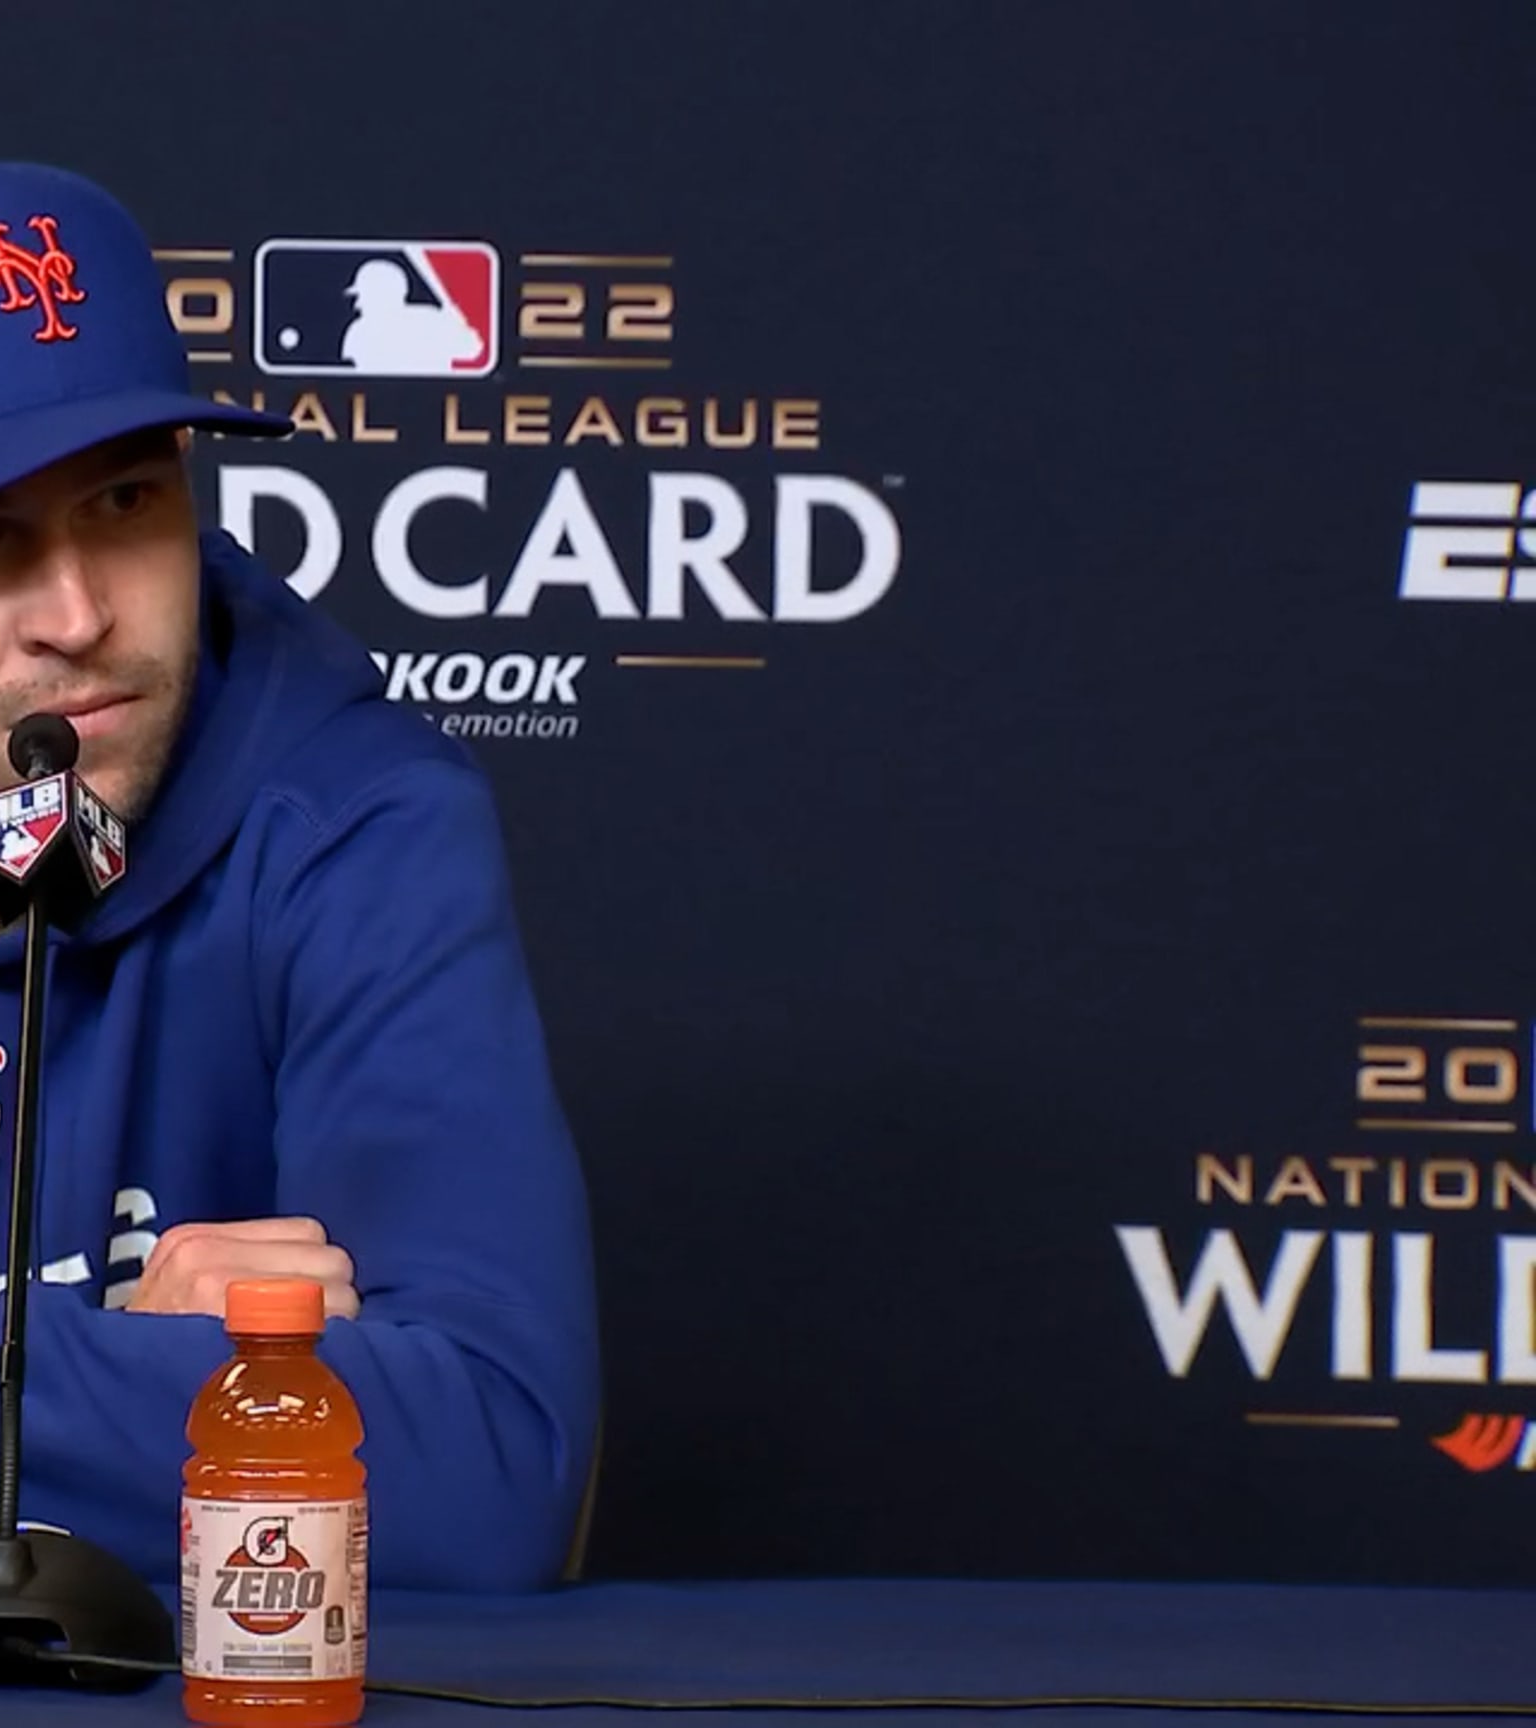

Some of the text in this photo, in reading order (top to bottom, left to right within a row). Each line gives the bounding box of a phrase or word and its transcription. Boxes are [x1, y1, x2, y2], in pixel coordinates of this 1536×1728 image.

[519, 283, 674, 340] 22
[444, 395, 821, 449] LEAGUE
[372, 466, 902, 623] CARD
[441, 710, 580, 738] emotion
[77, 786, 122, 848] MLB
[1357, 1046, 1518, 1103] 20
[243, 1516, 293, 1567] G
[212, 1569, 326, 1609] ZERO
